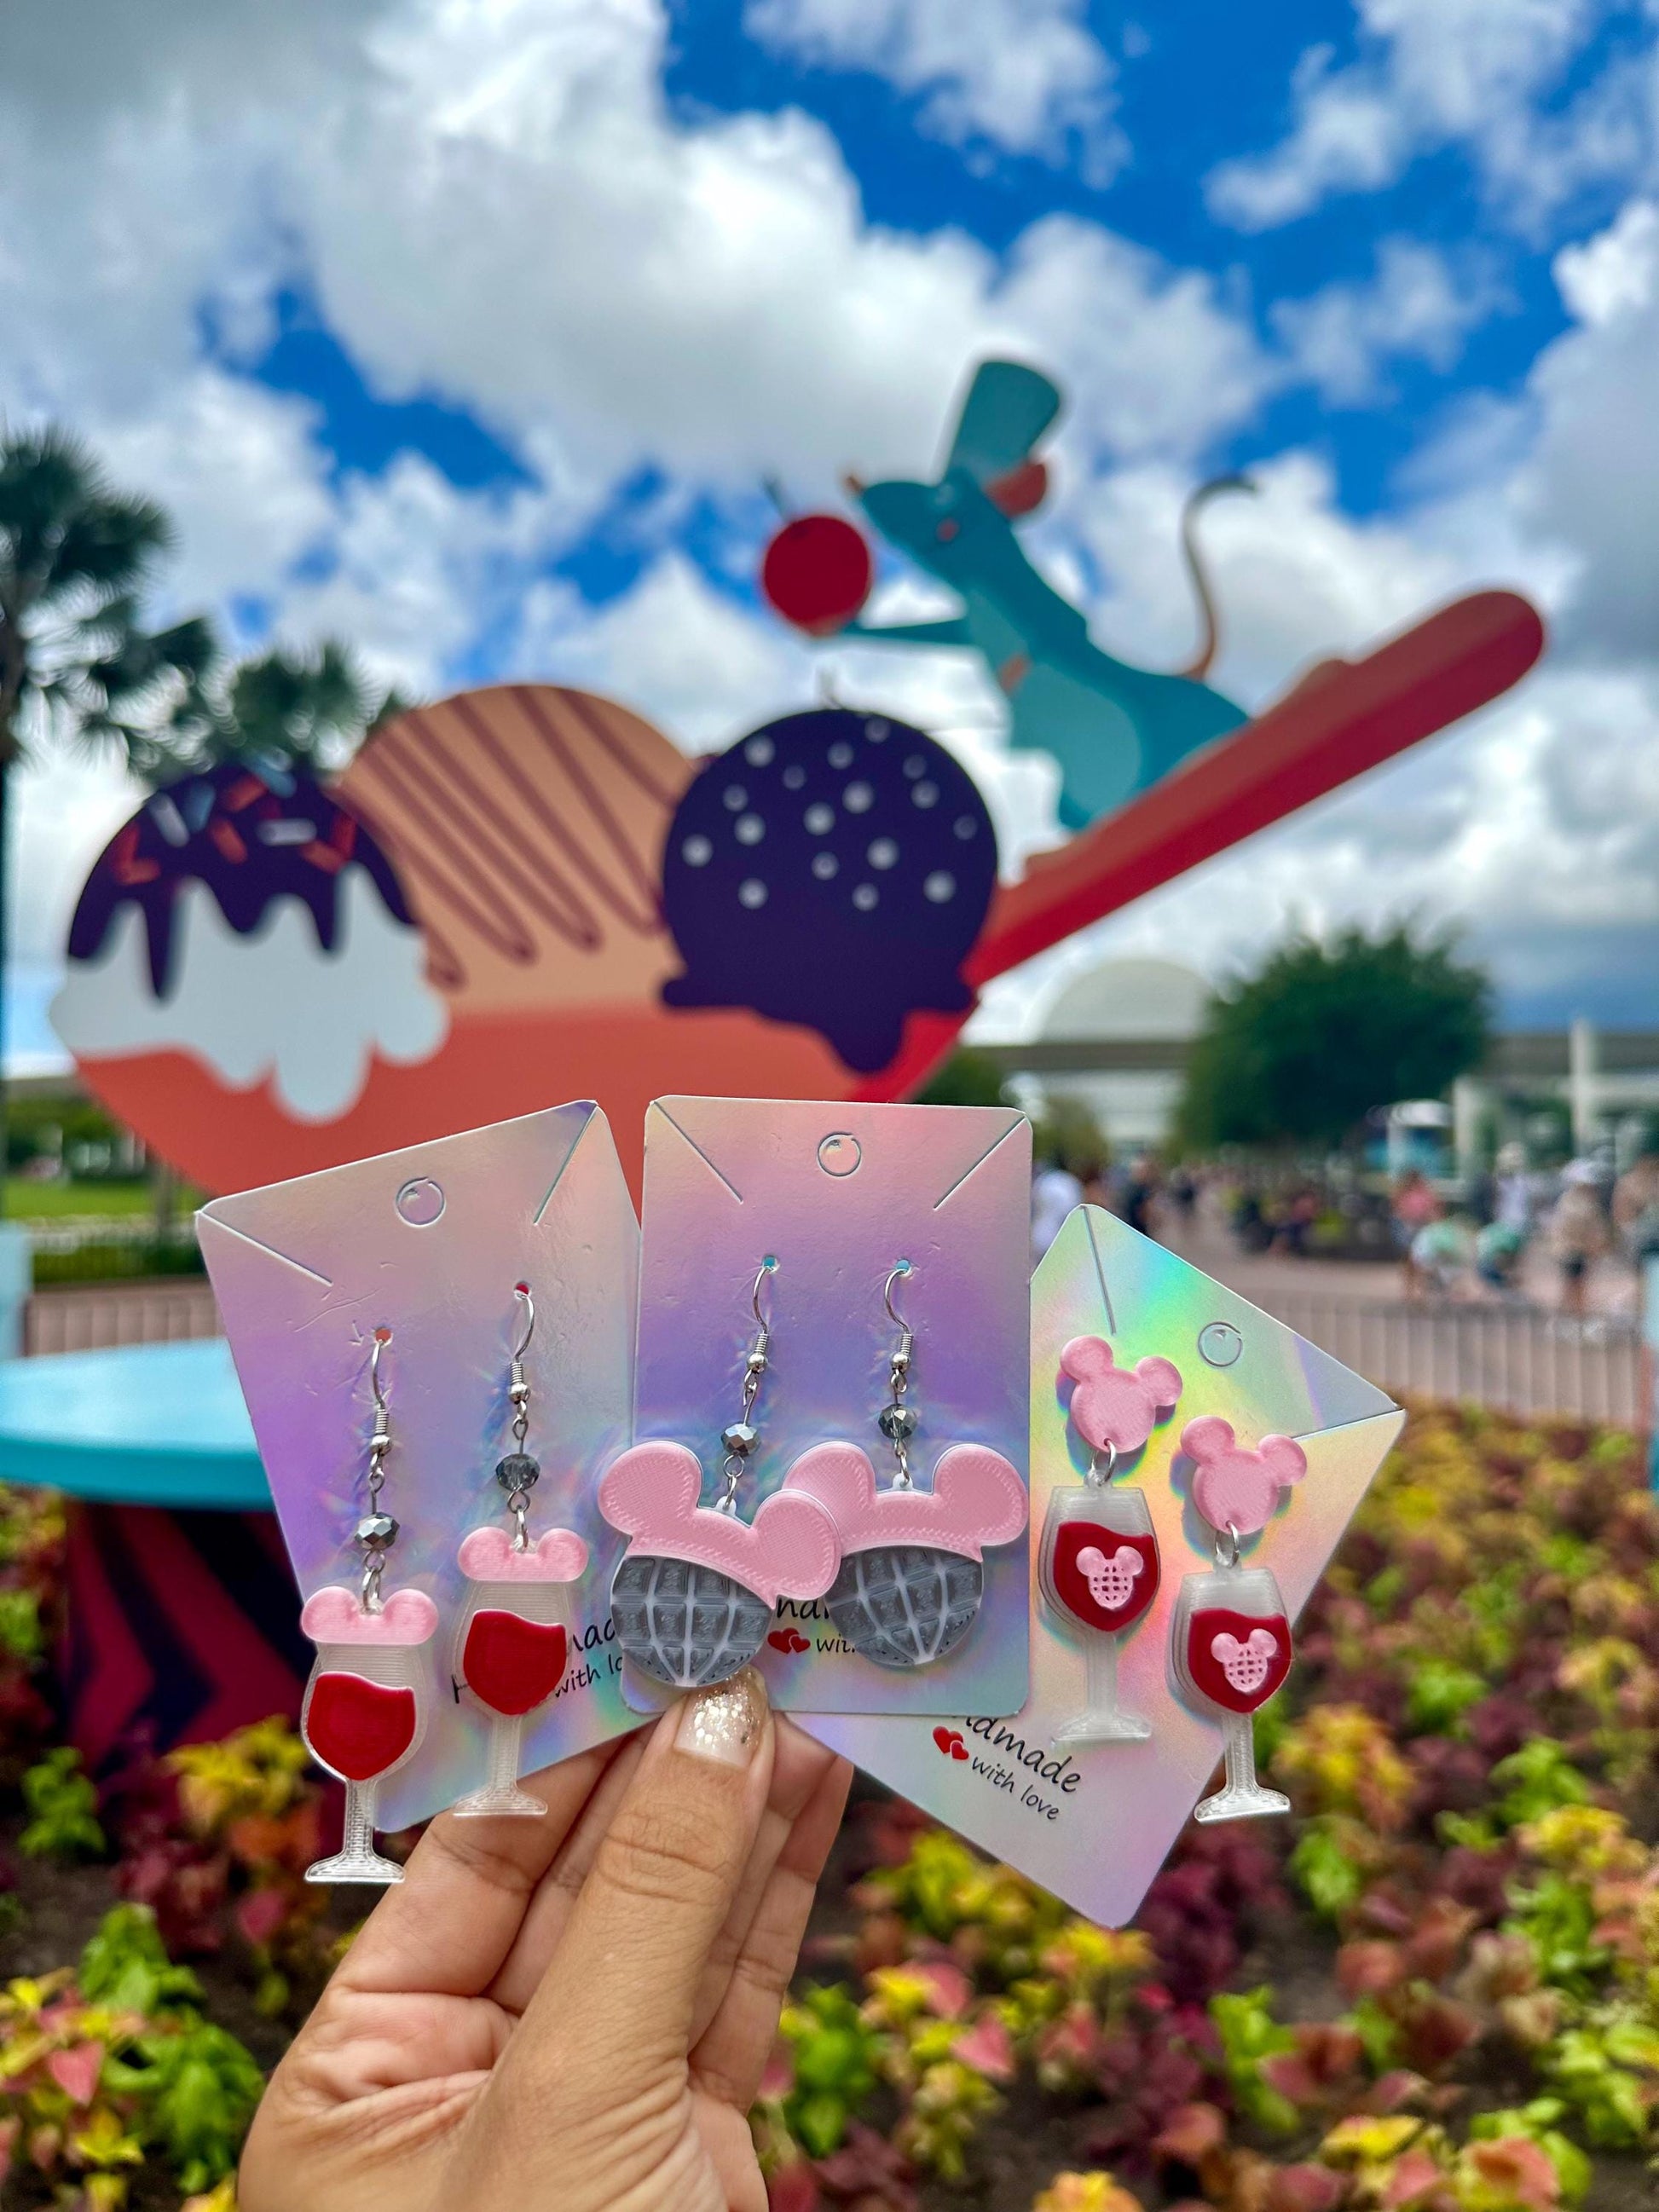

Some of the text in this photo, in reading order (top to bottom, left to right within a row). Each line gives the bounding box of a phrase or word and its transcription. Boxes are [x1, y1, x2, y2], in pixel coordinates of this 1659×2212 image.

[965, 1717, 1081, 1793] dmade
[972, 1756, 1059, 1820] with love
